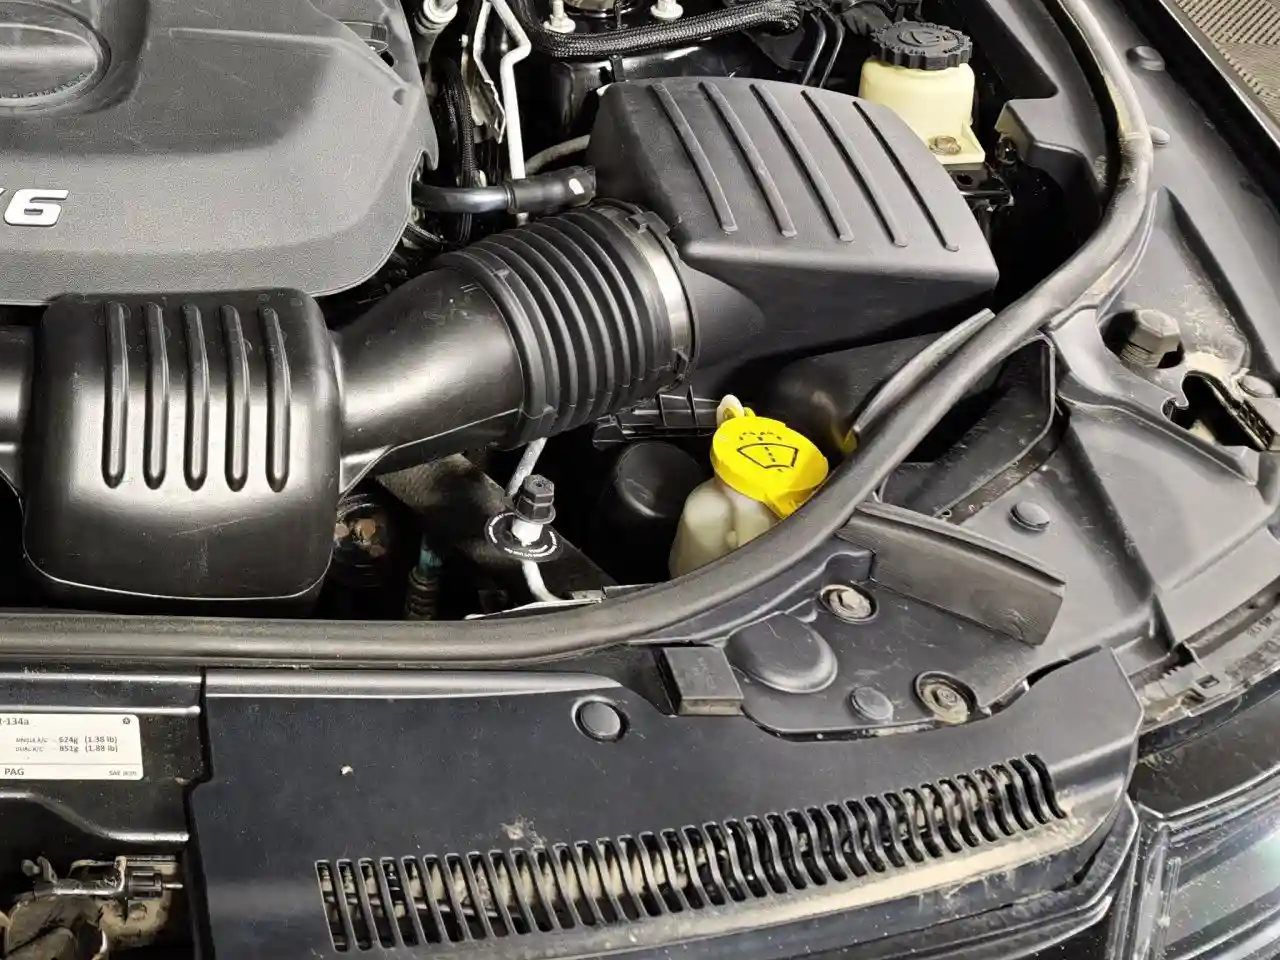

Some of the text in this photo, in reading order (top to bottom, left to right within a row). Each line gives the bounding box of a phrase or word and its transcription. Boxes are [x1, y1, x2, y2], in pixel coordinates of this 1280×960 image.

[58, 736, 79, 745] 624g
[106, 735, 118, 744] lb)
[59, 745, 80, 754] 851g
[107, 744, 118, 753] lb)
[4, 767, 25, 776] PAG
